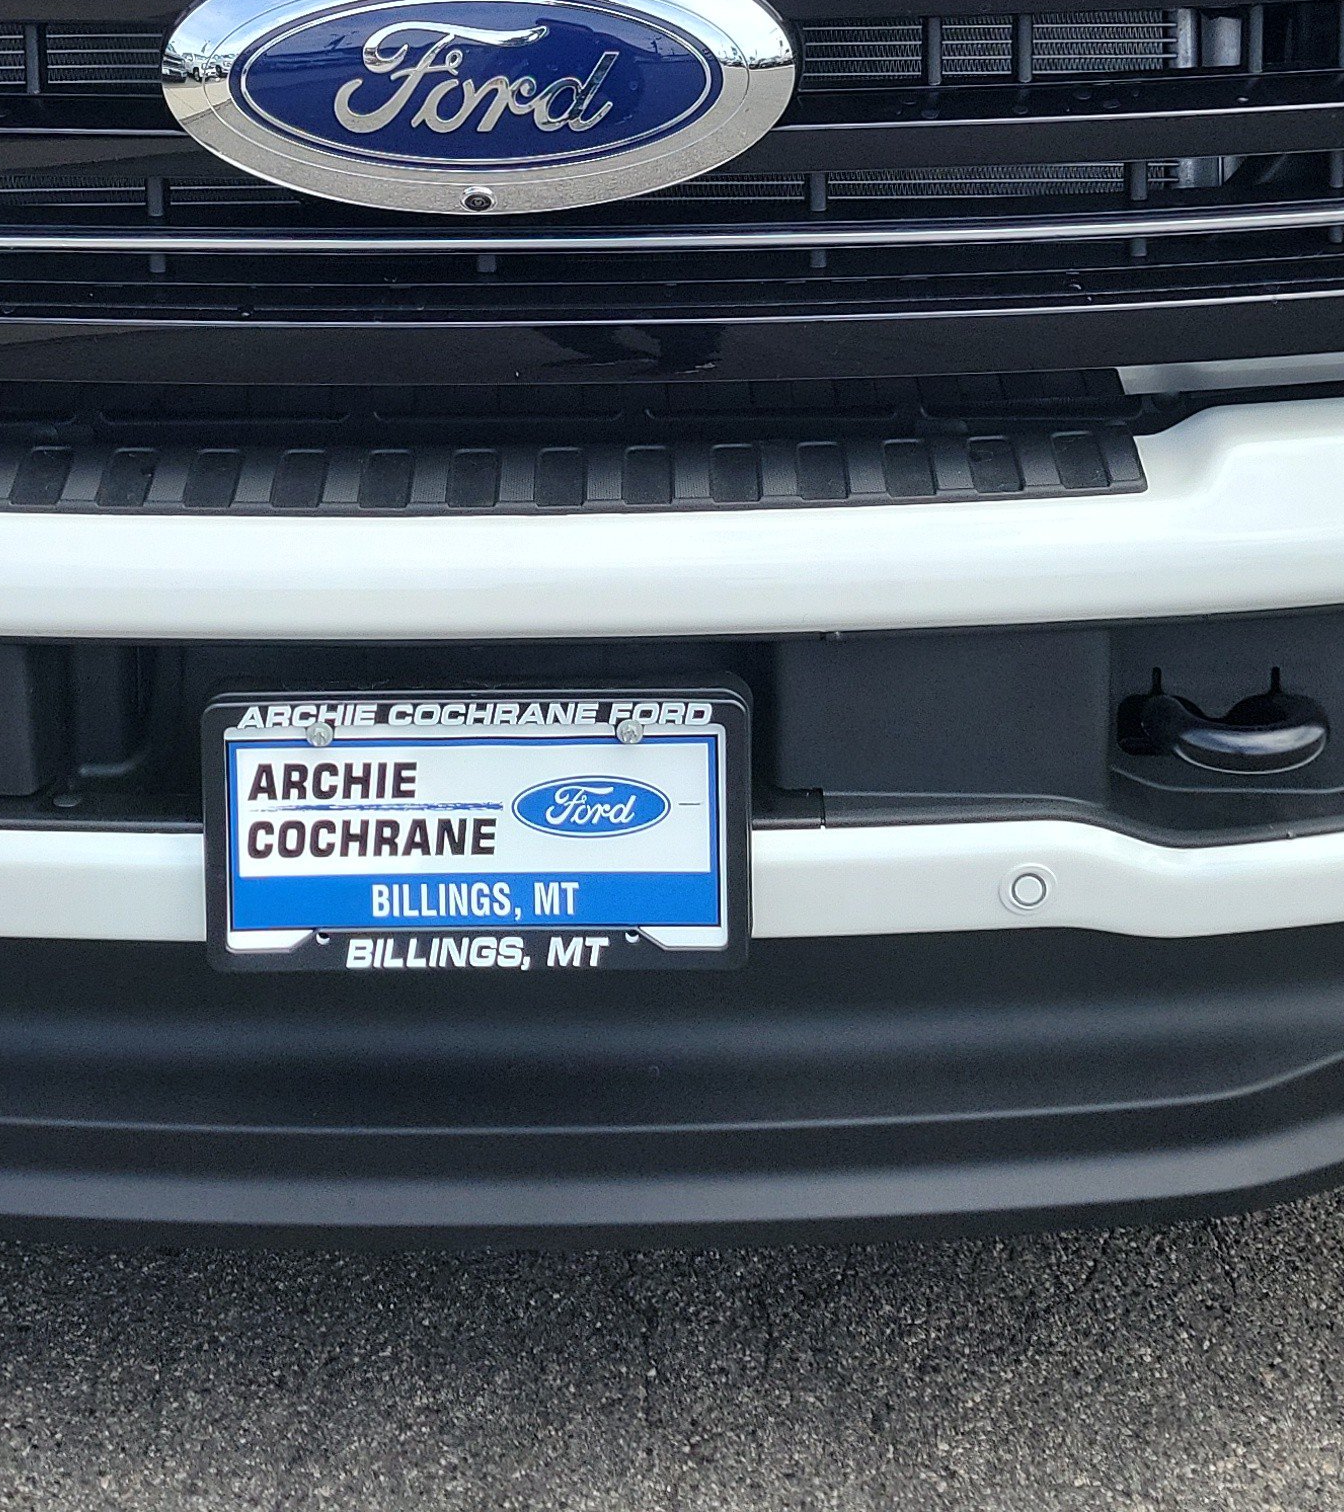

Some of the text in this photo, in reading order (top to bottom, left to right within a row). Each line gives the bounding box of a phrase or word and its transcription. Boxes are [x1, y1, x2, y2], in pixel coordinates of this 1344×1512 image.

[334, 20, 620, 133] Ford
[237, 702, 713, 729] ARCHIE COCHRANE FORD
[247, 761, 418, 801] ARCHIE
[544, 786, 637, 826] Ford
[246, 817, 497, 859] COCHRANE
[372, 881, 579, 921] BILLINGS, MT
[347, 936, 610, 970] BILLINGS, MT
